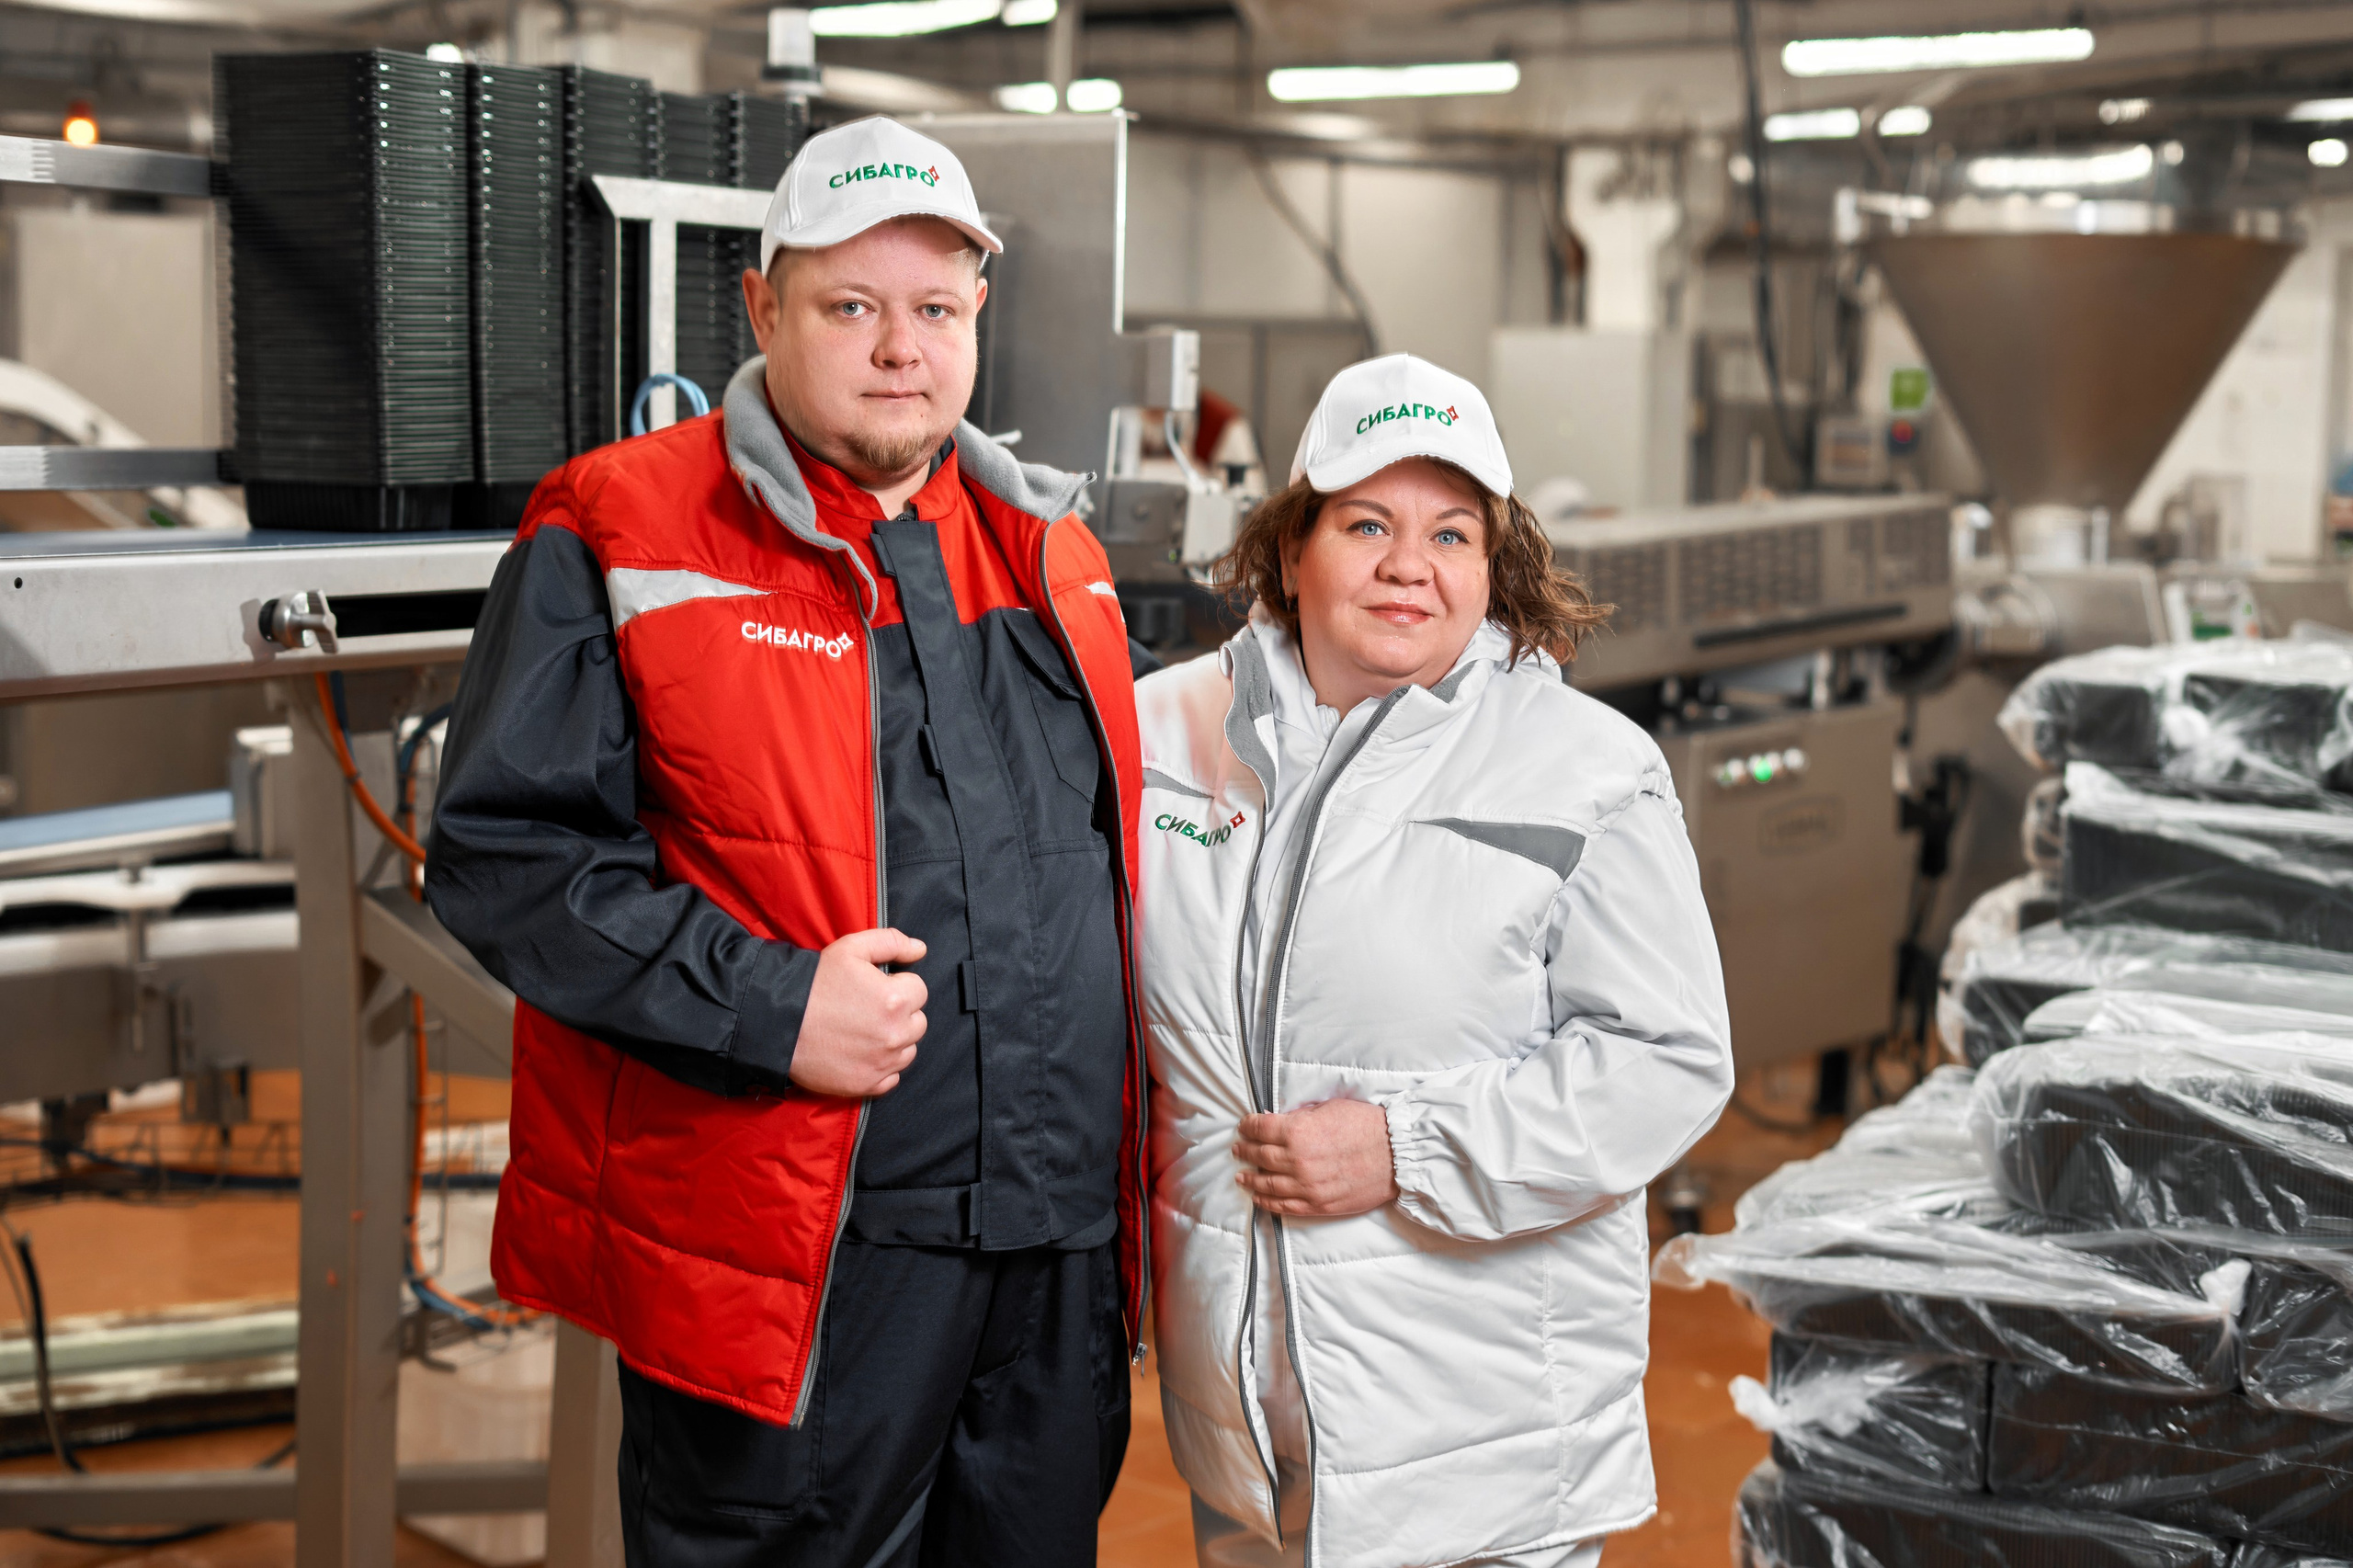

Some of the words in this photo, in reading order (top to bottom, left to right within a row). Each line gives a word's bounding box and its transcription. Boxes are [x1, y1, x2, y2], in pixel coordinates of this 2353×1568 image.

[829, 163, 935, 188] СИБАГРО
[1357, 403, 1451, 435] СИБАГРО
[741, 621, 842, 658] СИБАГРО
[1154, 813, 1232, 847] СИБАГРО
